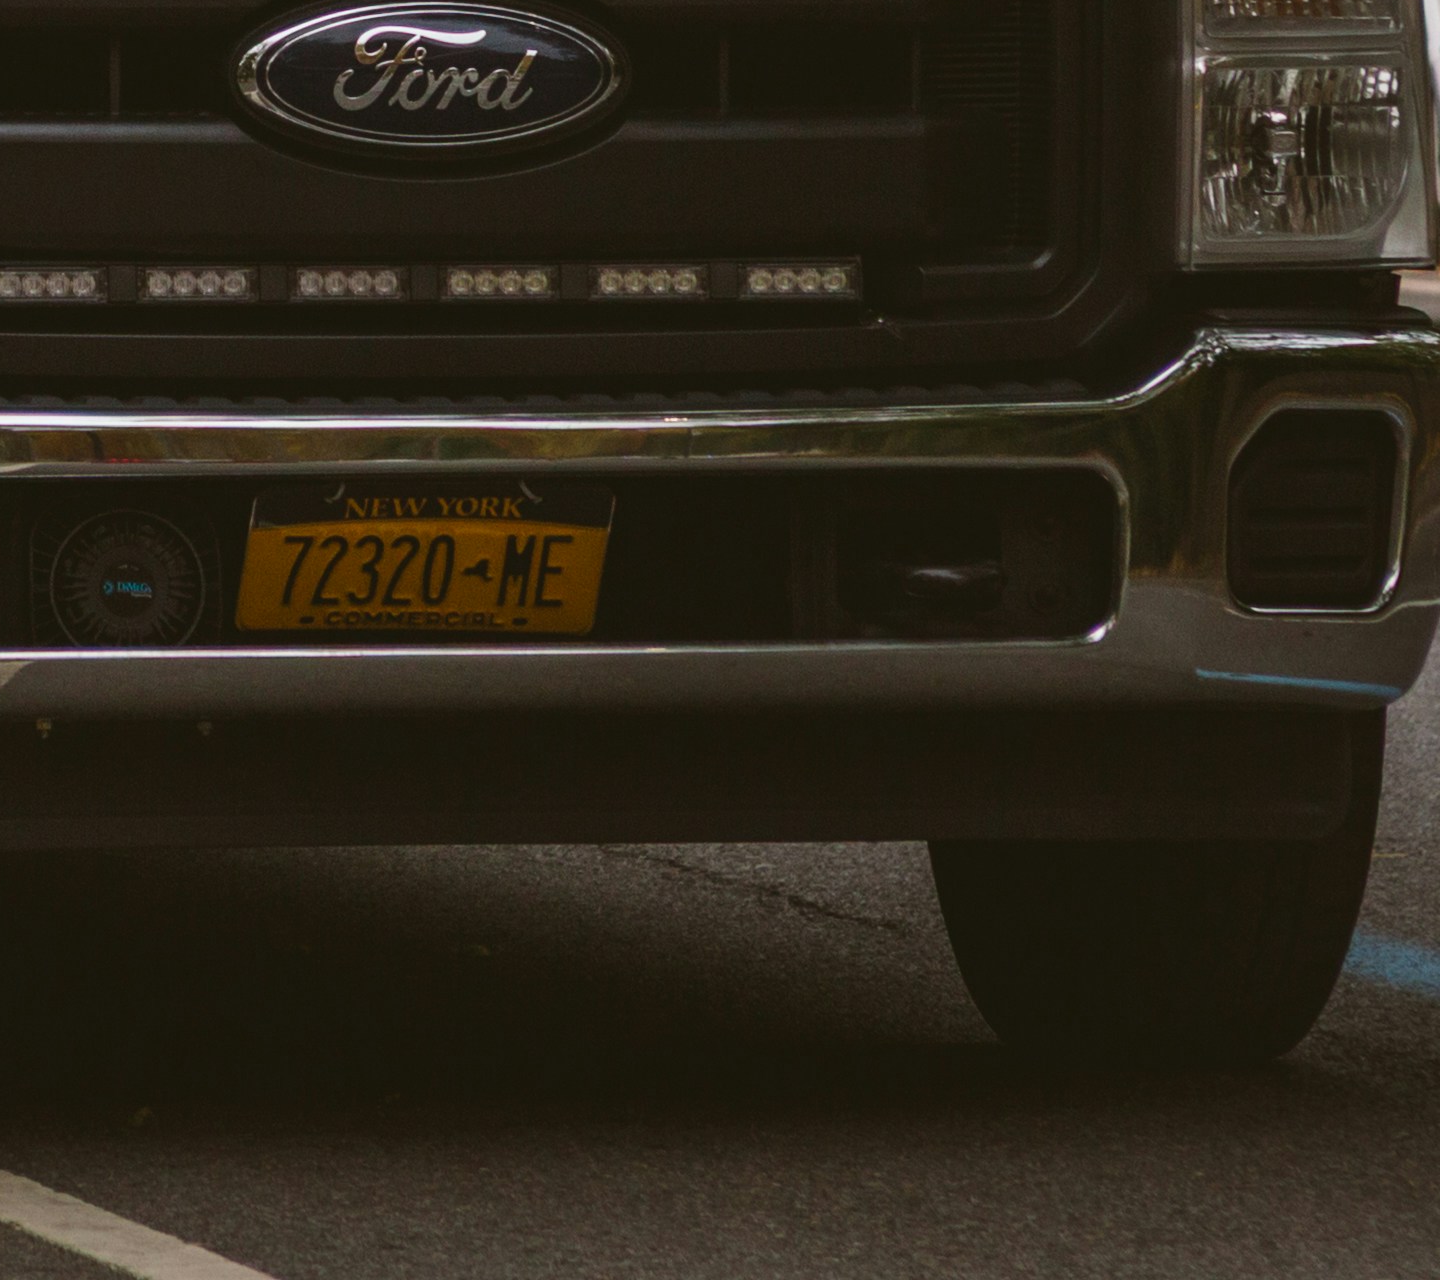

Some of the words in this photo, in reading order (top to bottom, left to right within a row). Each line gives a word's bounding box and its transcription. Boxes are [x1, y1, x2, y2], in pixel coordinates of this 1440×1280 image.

[333, 25, 538, 111] Ford
[344, 497, 427, 519] NEW
[436, 497, 524, 519] YORK
[324, 610, 504, 628] COMMERCIAL
